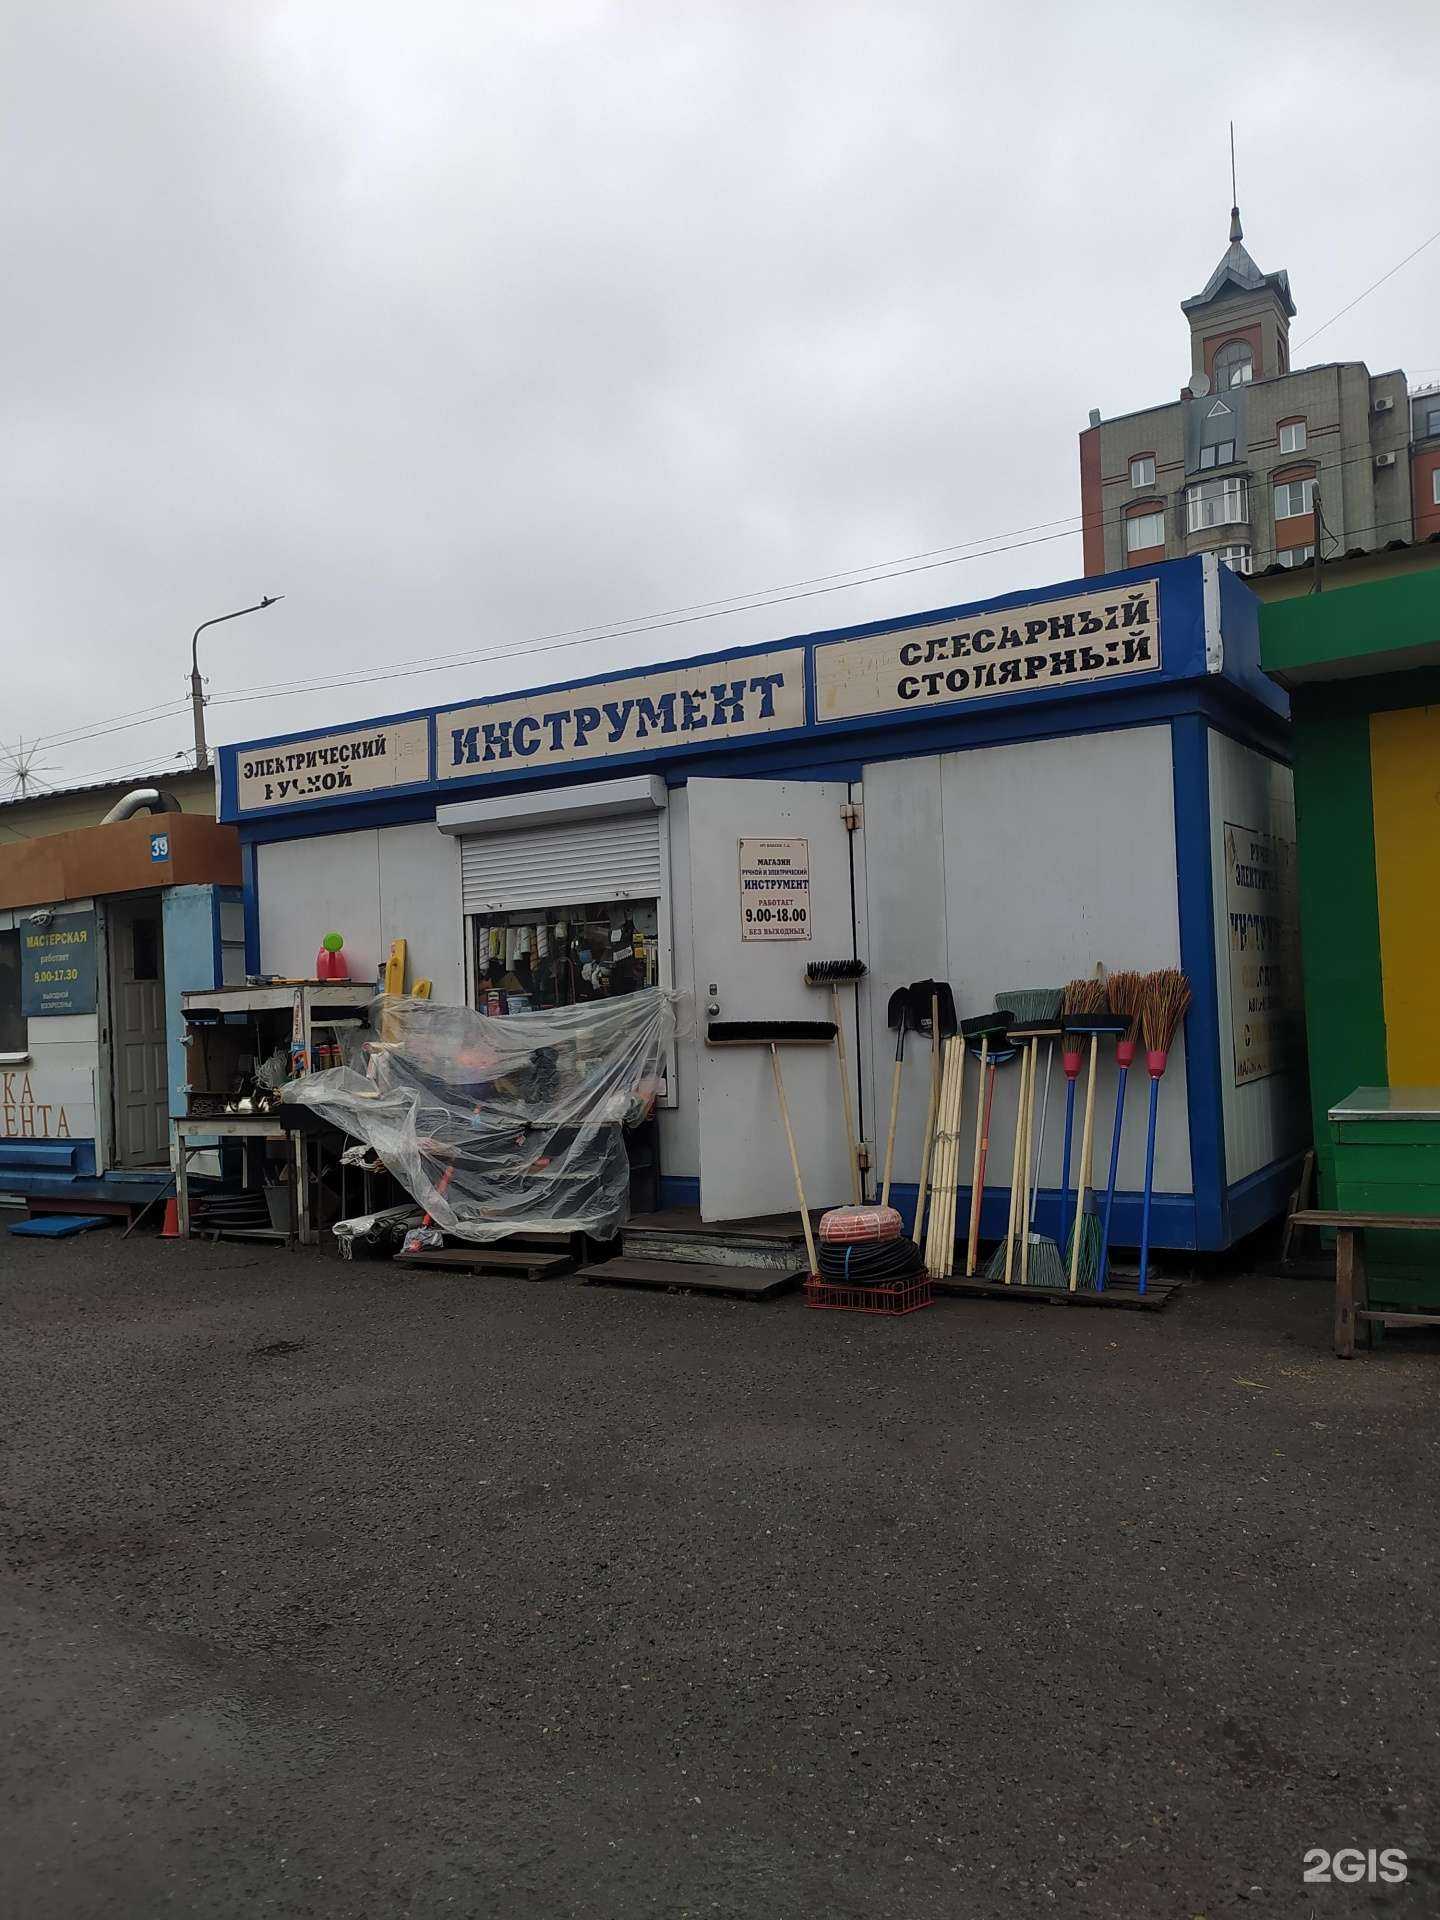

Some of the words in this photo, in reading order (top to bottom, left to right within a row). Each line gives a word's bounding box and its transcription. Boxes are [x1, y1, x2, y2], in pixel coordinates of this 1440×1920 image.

[899, 593, 1150, 666] СЛЕСАРНЫЙ
[897, 630, 1151, 700] СТОЛЯРНЫЙ
[450, 673, 785, 766] ИНСТРУМЕНТ
[243, 734, 387, 779] ЭЛЕКТРИЧЕСКИЙ
[152, 837, 168, 856] 39
[757, 858, 791, 866] МАГАЗИН
[744, 879, 809, 890] ИНСТРУМЕНТ
[745, 908, 807, 922] 9.00-18.00
[26, 930, 88, 948] МАСТЕРСКАЯ
[749, 928, 762, 936] БЕЗ
[763, 927, 805, 937] ВЫХОДНЫХ
[34, 968, 78, 983] 9.00-17.30
[0, 1104, 71, 1137] ЕНТА
